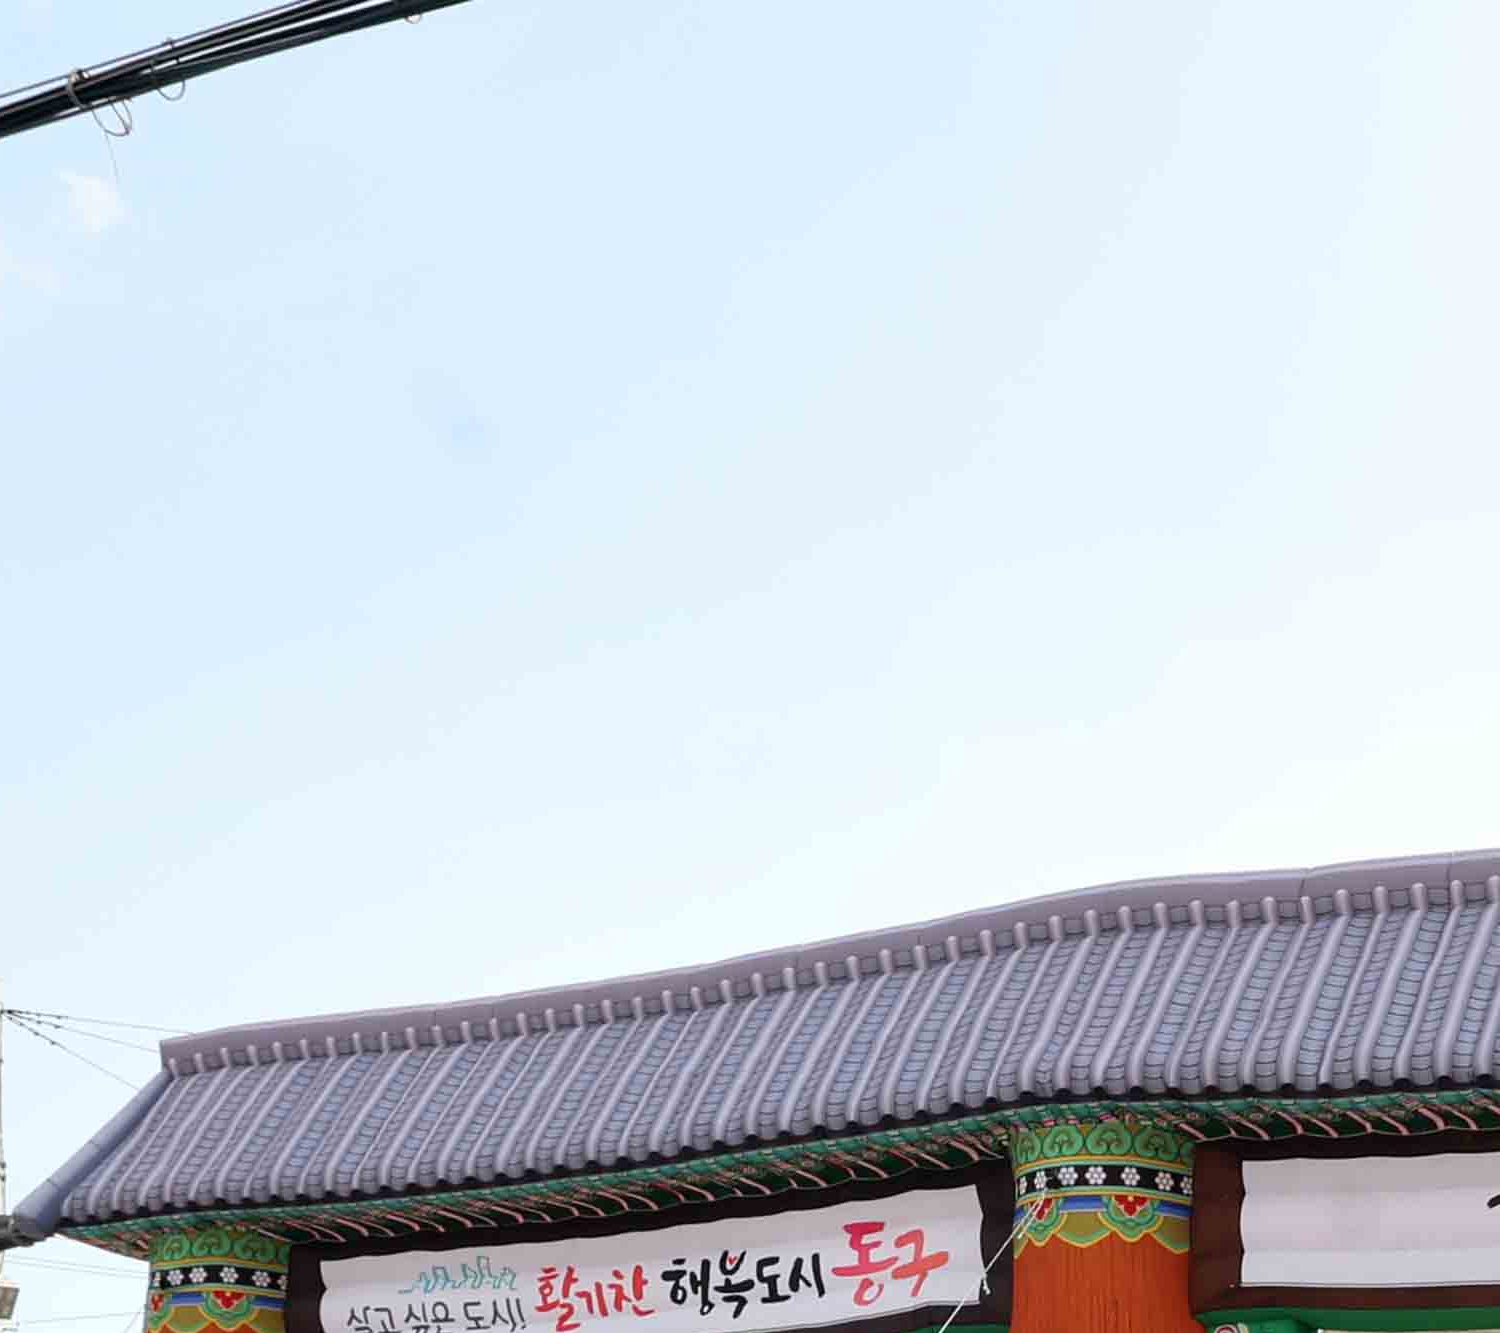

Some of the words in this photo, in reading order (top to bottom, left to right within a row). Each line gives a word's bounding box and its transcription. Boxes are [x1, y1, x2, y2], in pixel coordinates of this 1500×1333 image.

[463, 1298, 526, 1332] 도시!
[535, 1264, 660, 1332] 활기찬
[661, 1250, 826, 1319] 행복도시
[832, 1221, 950, 1306] 동구
